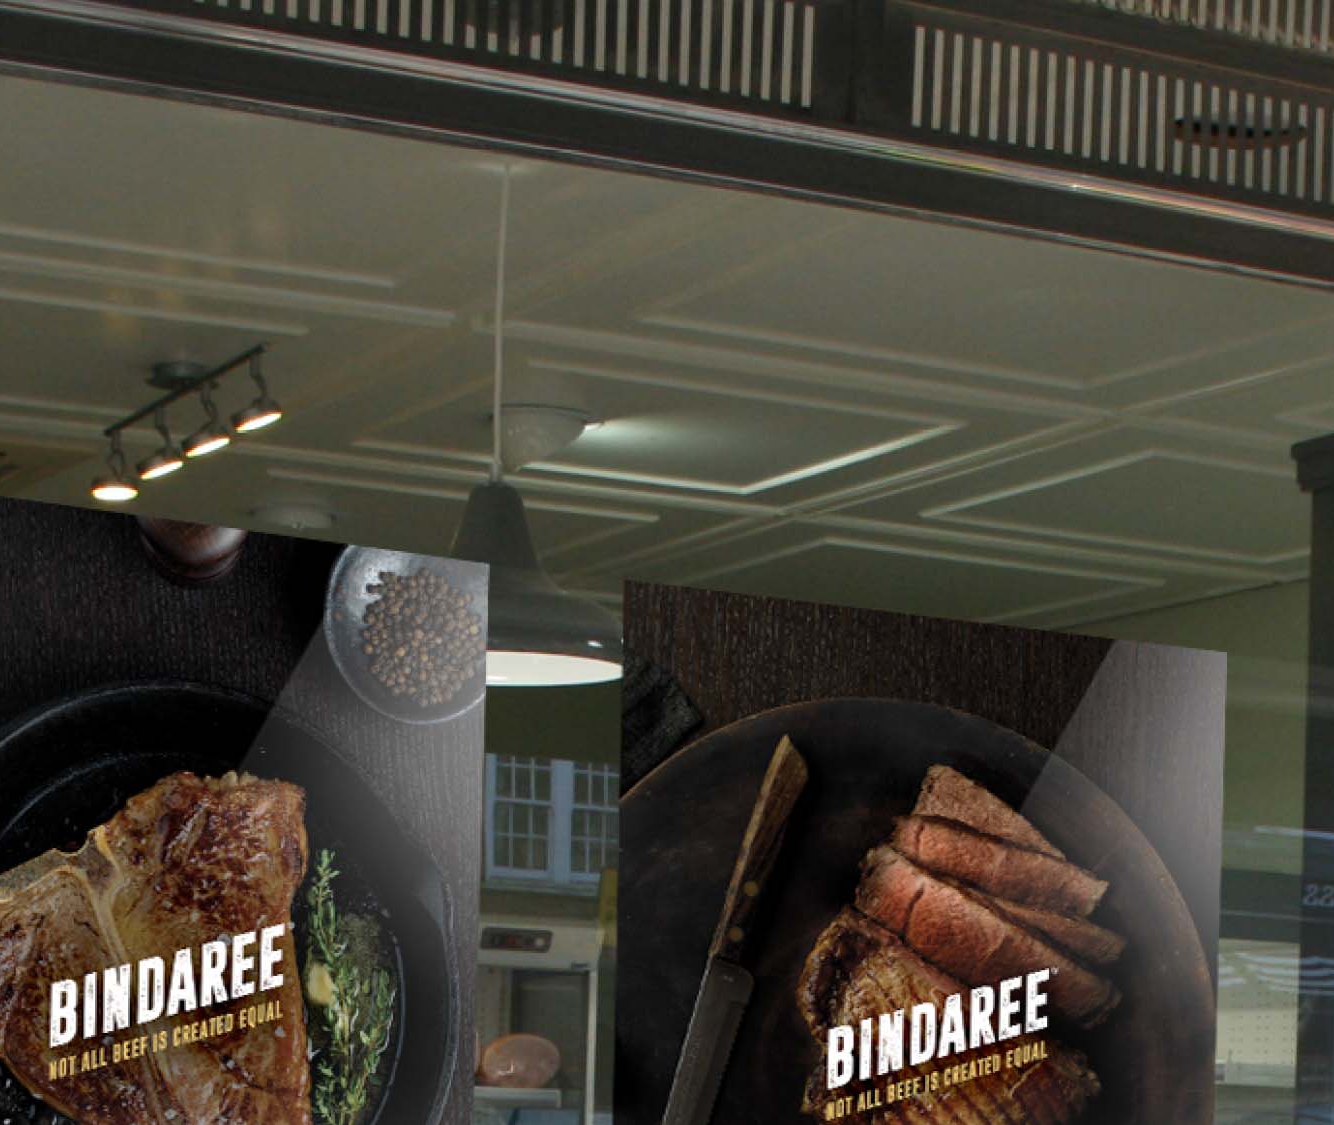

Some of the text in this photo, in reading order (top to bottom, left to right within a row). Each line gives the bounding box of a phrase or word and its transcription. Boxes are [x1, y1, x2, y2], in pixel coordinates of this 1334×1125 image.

[49, 923, 286, 1049] BINDAREE
[826, 968, 1051, 1090] BINDAREE
[48, 1000, 284, 1081] NOT ALL BEEF IS CREATED EQUAL
[824, 1040, 1049, 1121] NOT ALL BEEF IS CREATED EQUAL
